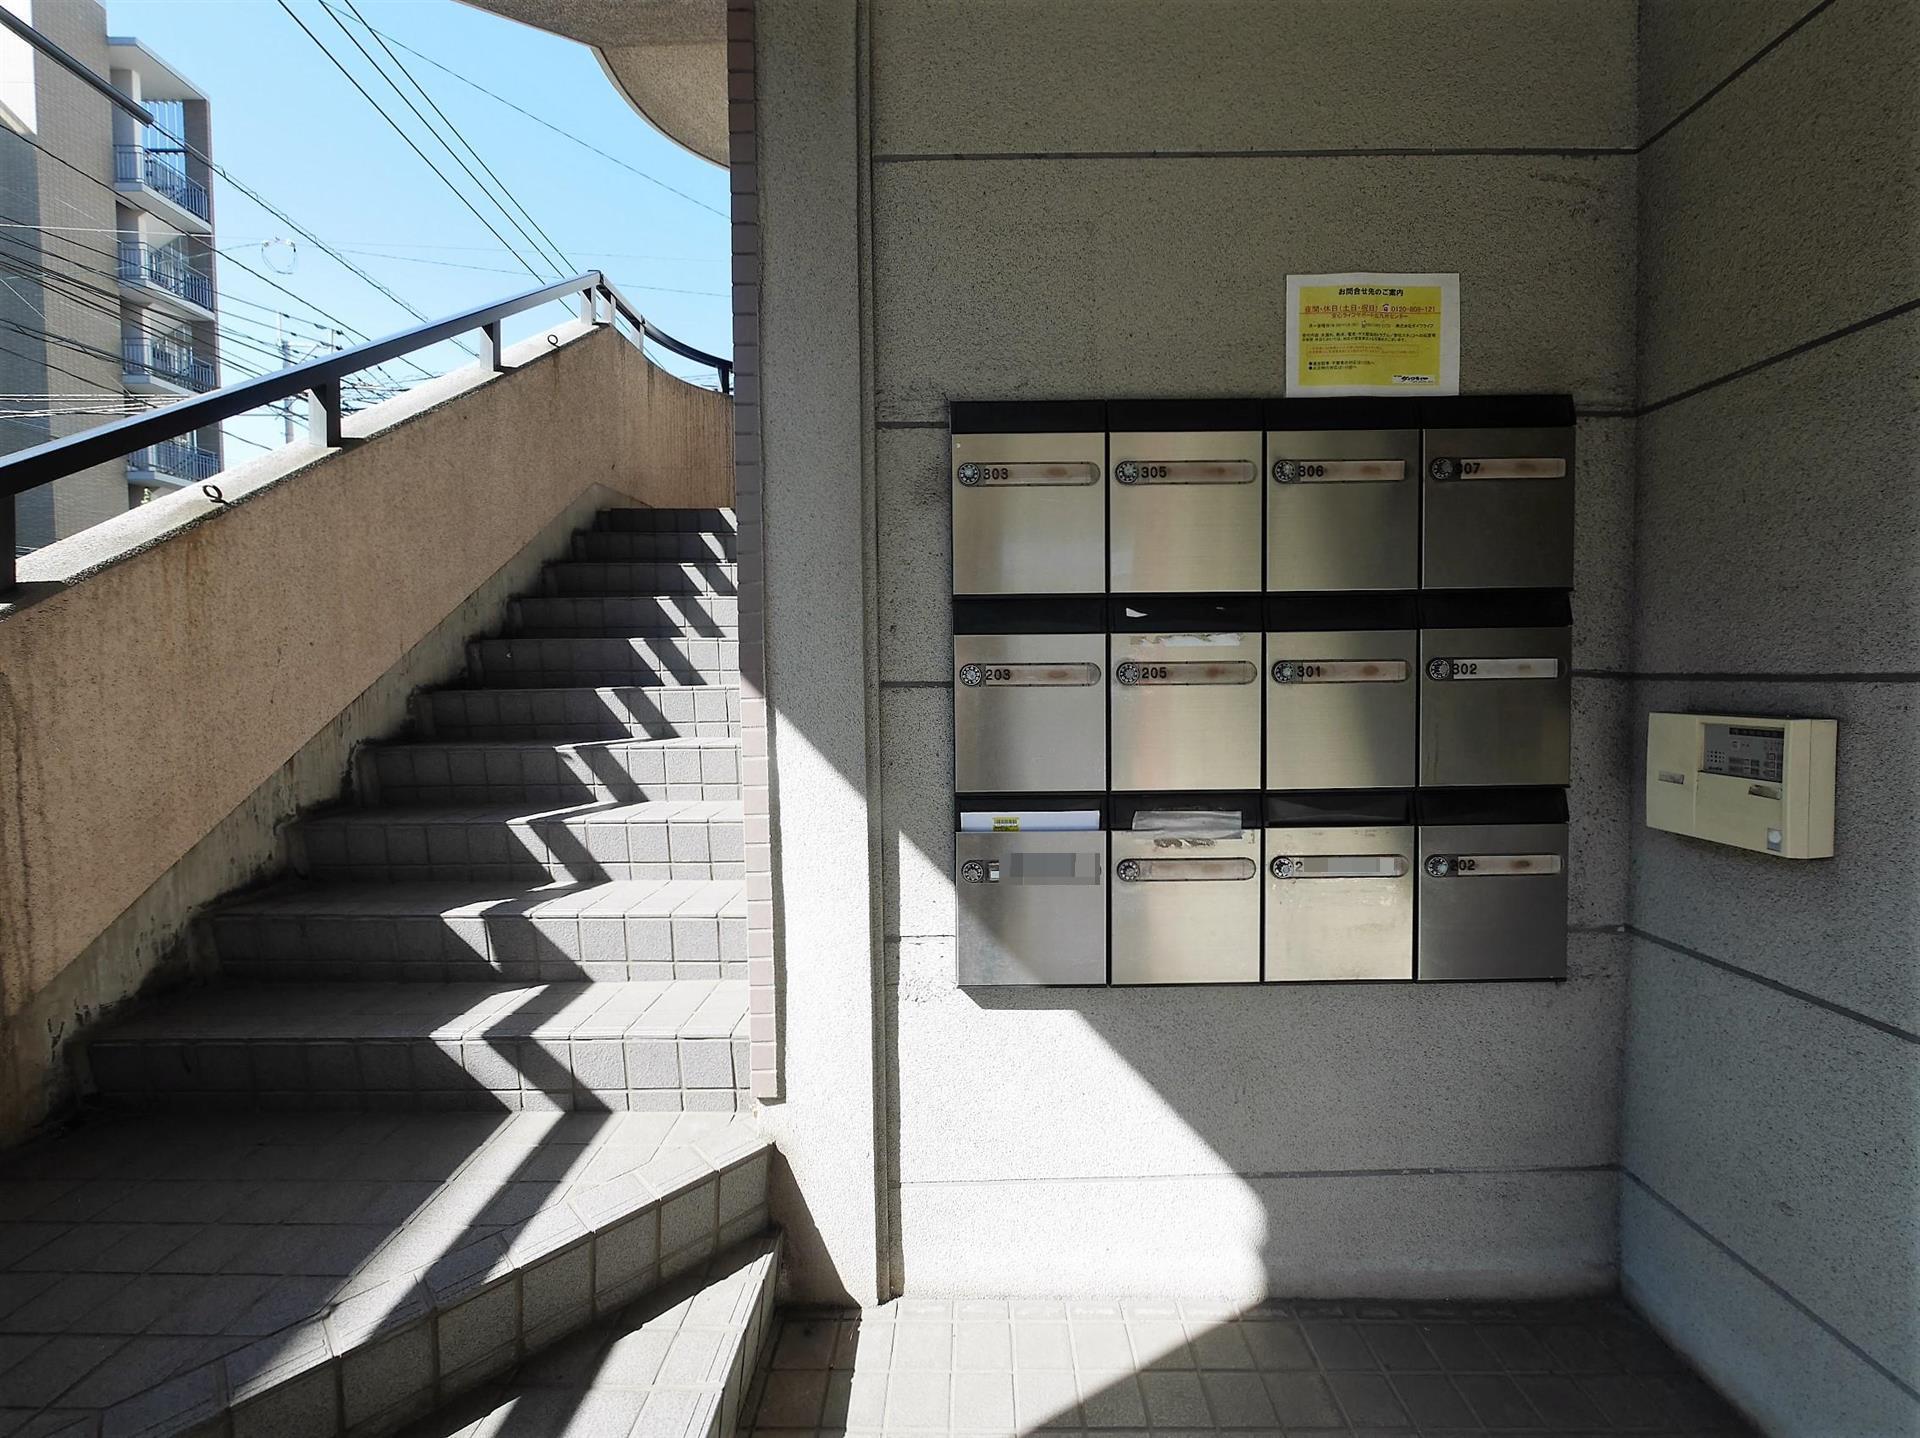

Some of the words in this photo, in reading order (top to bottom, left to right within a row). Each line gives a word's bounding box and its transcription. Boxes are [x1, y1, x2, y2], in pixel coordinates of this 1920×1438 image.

[1338, 287, 1404, 297] お問合せ先のご案内
[982, 467, 1010, 481] 303
[1140, 466, 1168, 479] 305
[1298, 464, 1325, 478] 306
[985, 668, 1012, 681] 203
[1141, 666, 1168, 679] 205
[1296, 665, 1322, 678] 301
[1451, 663, 1478, 675] 302
